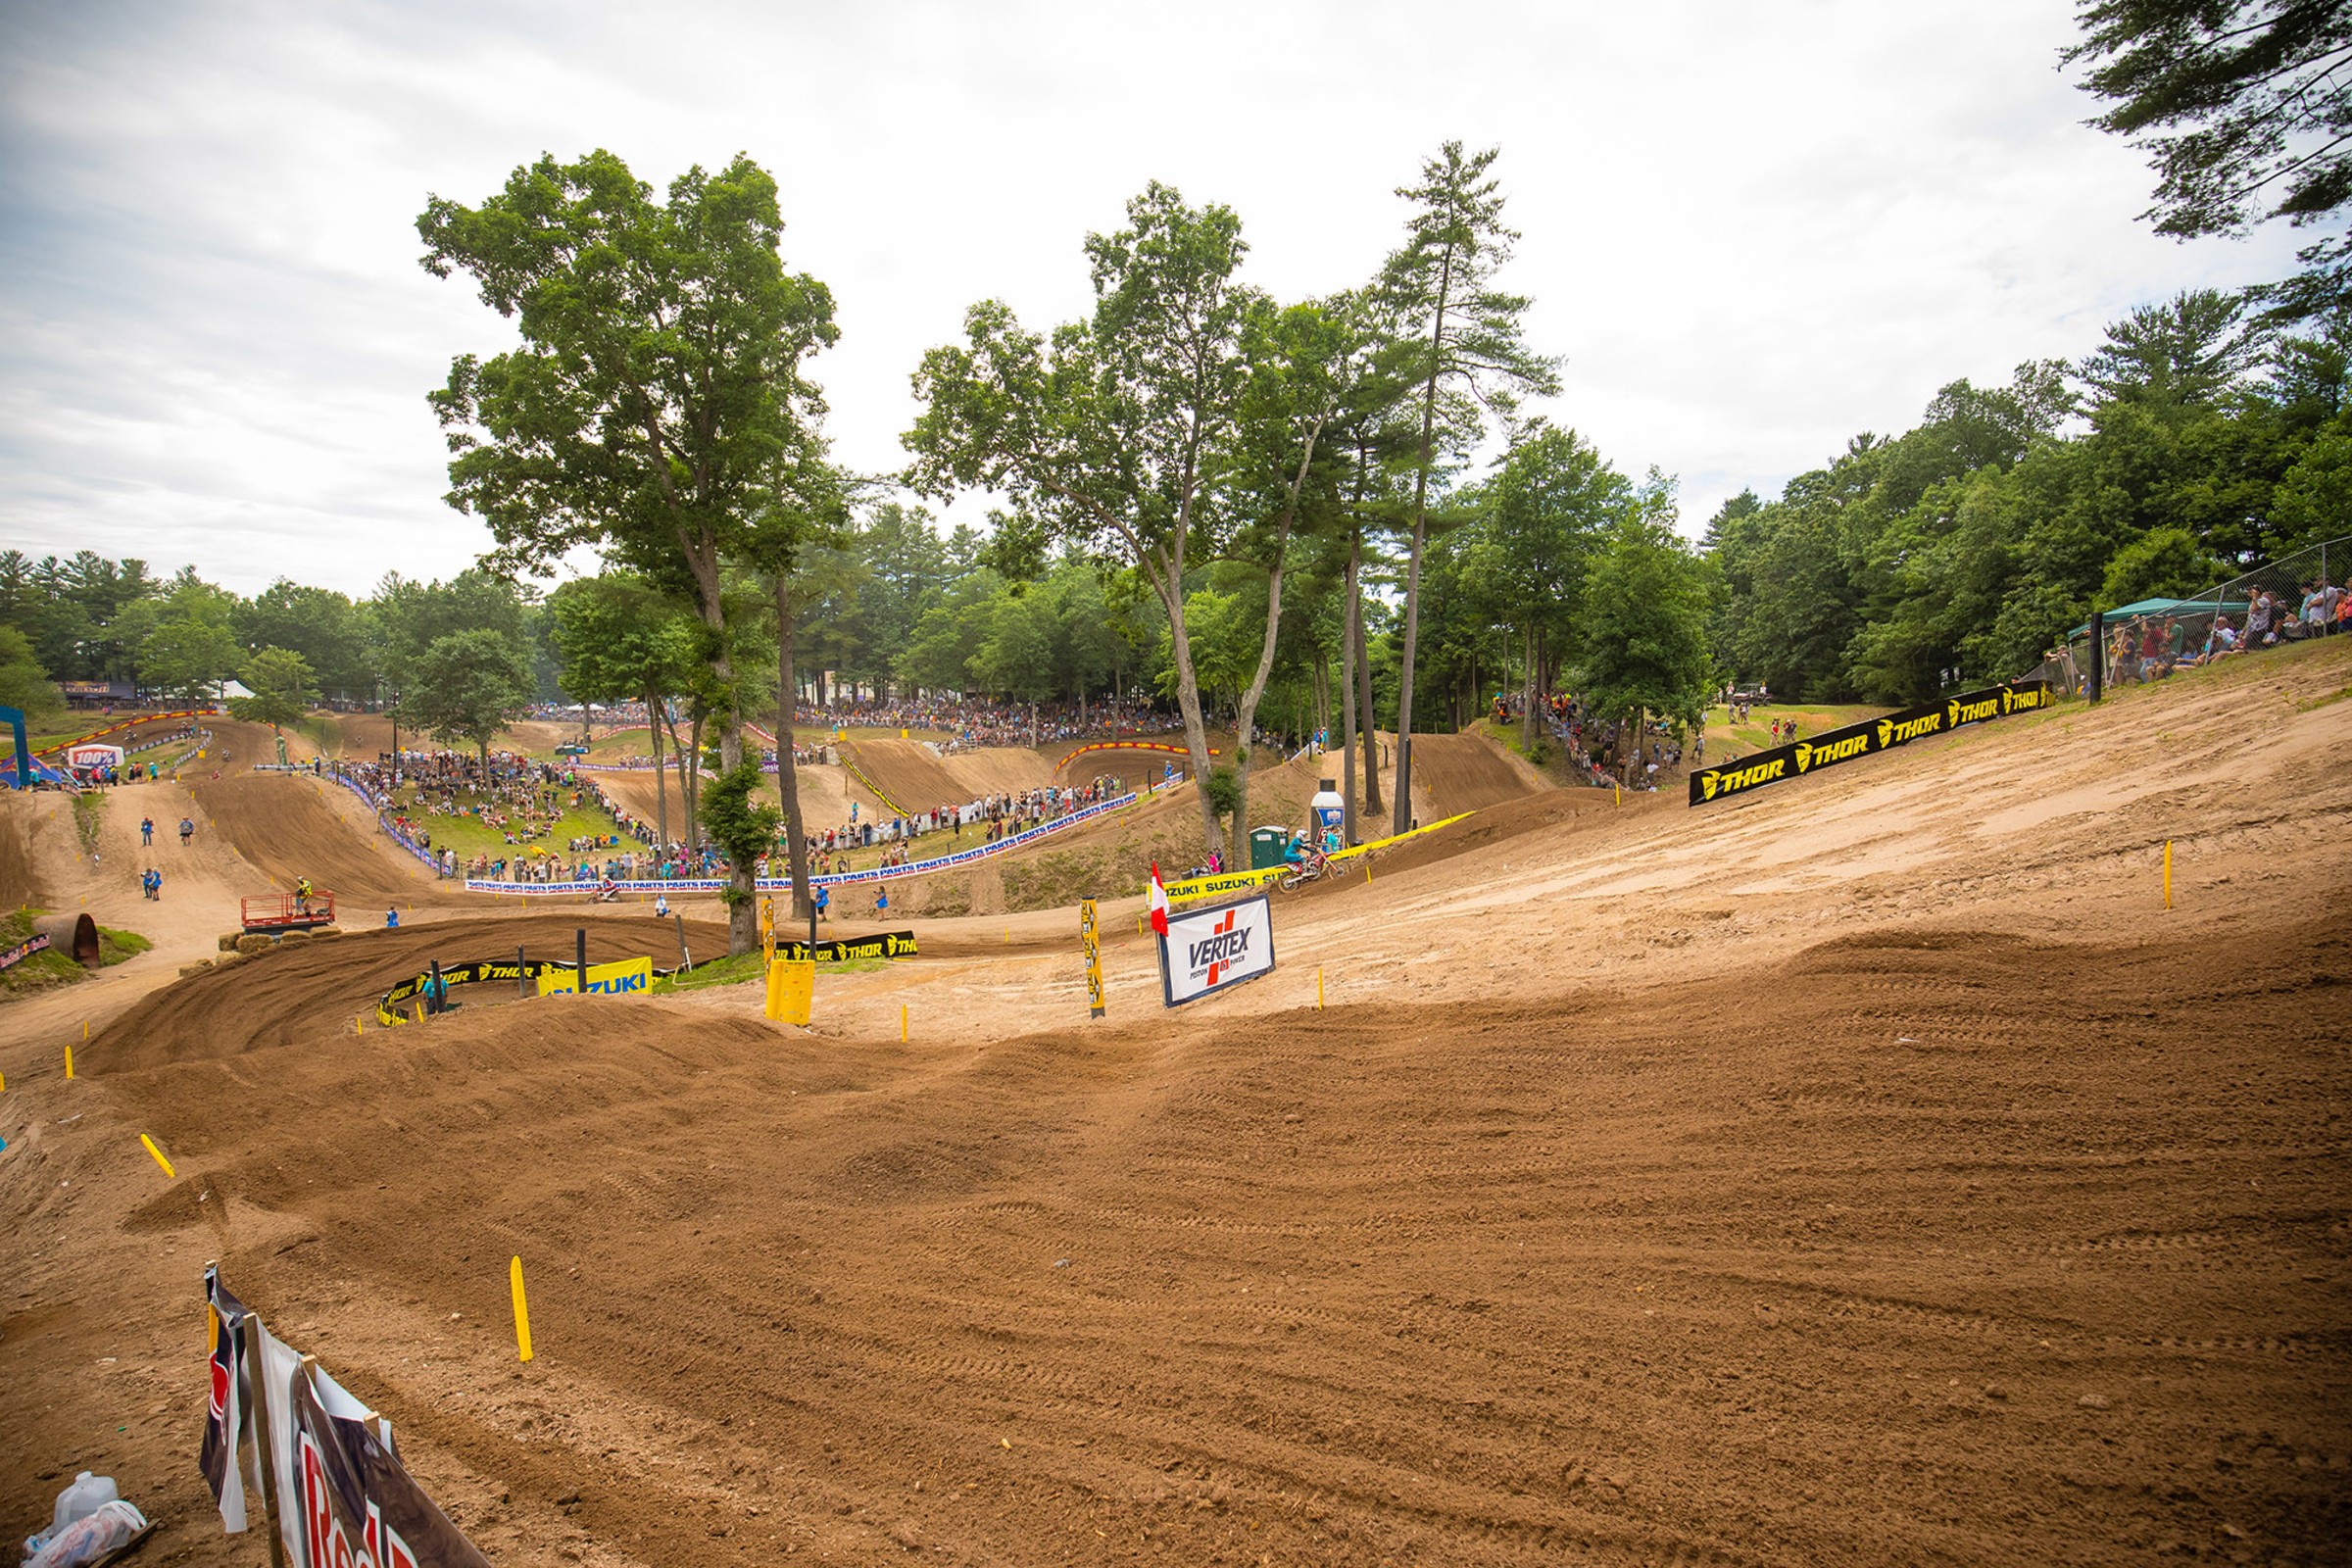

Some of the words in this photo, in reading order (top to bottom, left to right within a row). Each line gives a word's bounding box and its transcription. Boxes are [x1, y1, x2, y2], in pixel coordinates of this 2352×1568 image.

[76, 751, 114, 764] 100%
[1721, 760, 1785, 792] THOR
[1813, 734, 1869, 765] THOR
[1893, 712, 1941, 740] THOR
[1961, 698, 1998, 723] THOR
[843, 871, 878, 881] PARTS
[880, 864, 914, 876] PARTS
[916, 858, 950, 870] PARTS
[952, 849, 984, 862] PARTS
[985, 838, 1015, 854] PARTS
[1016, 826, 1046, 843] PARTS
[1047, 815, 1075, 832] PARTS
[1075, 806, 1101, 822] PARTS
[1101, 798, 1124, 812] PARTS
[1166, 885, 1199, 897] ZUKI
[1205, 877, 1255, 892] SUZUKI
[802, 950, 833, 961] TOR
[847, 943, 882, 959] THOR
[1189, 926, 1252, 968] VERTEX
